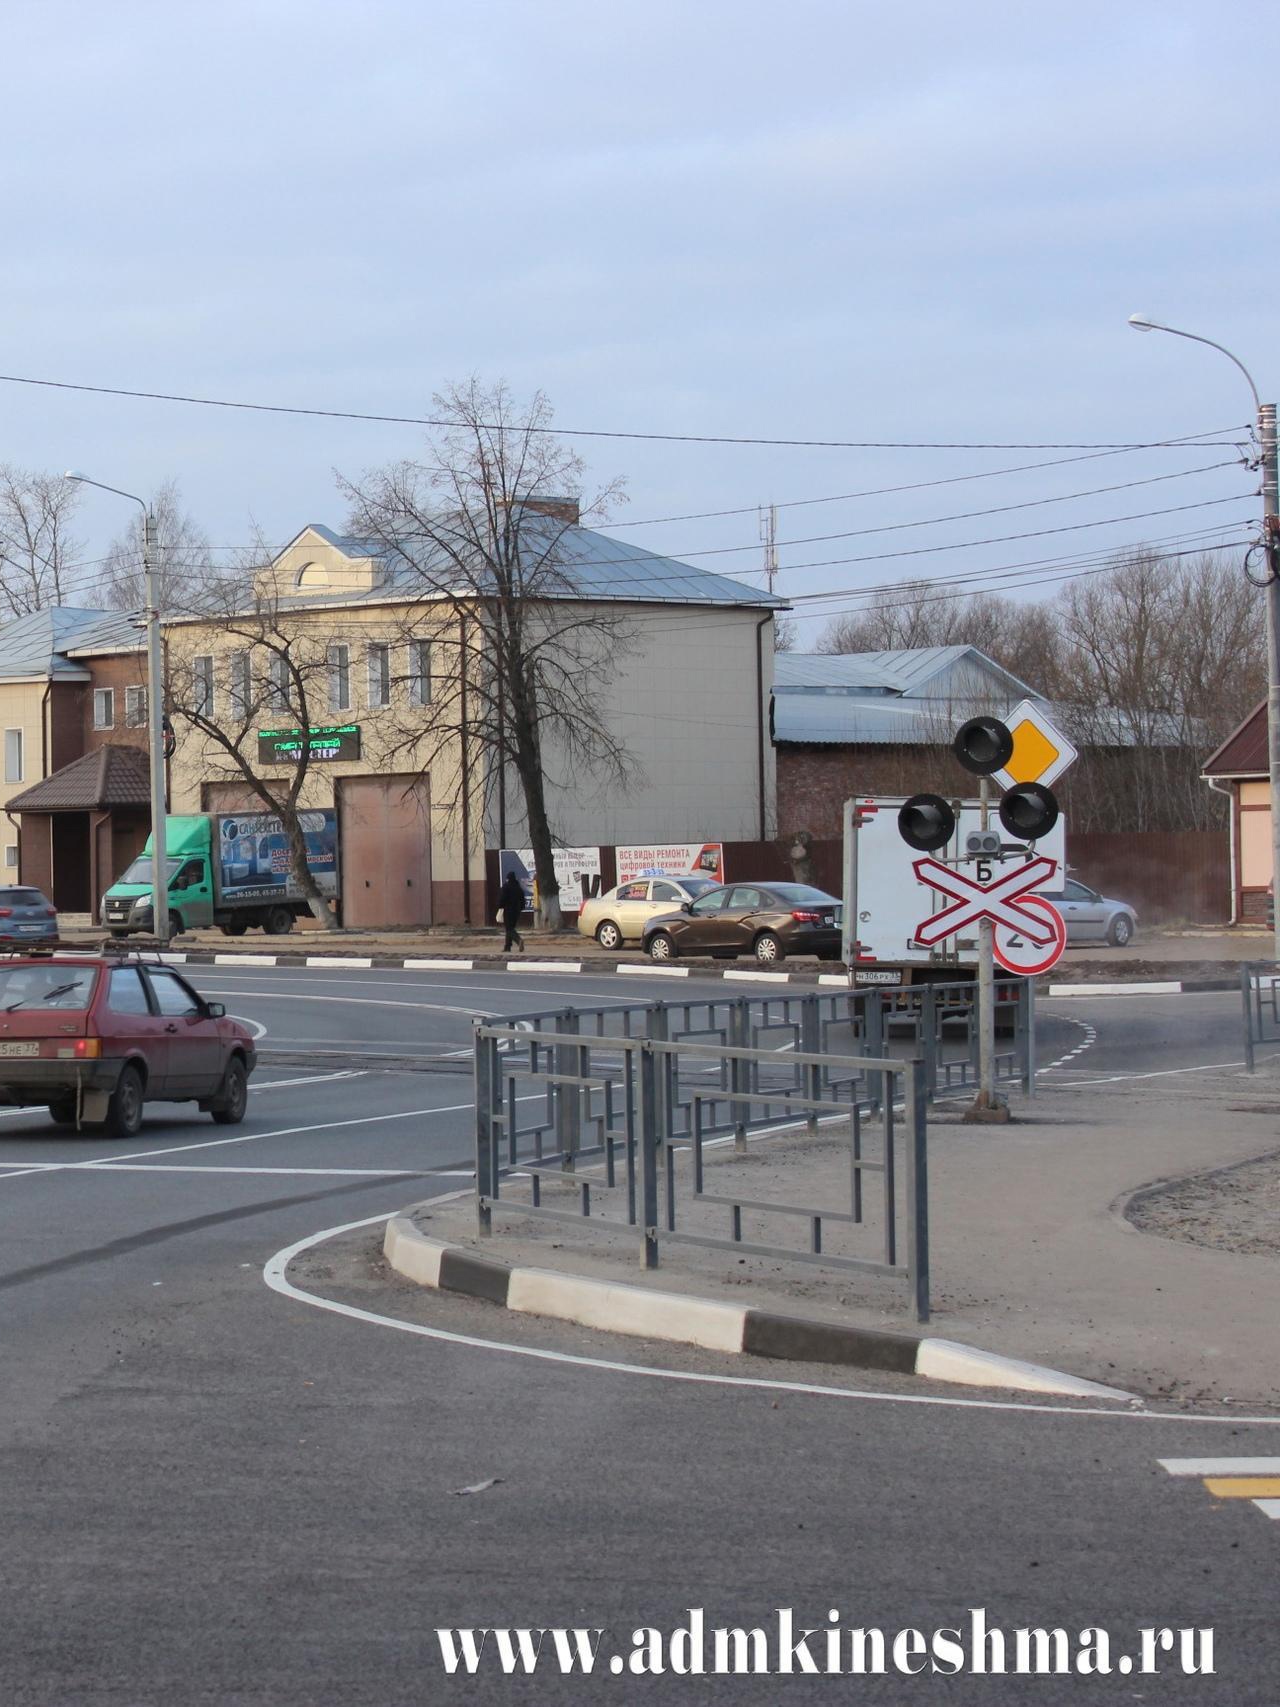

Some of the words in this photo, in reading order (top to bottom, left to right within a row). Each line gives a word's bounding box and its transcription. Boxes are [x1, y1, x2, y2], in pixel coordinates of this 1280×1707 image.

[619, 850, 633, 860] ВСЕ
[634, 849, 655, 860] ВИДЫ
[656, 848, 690, 859] РЕМОНТА
[619, 860, 655, 871] цифровой
[657, 861, 687, 869] техники
[976, 860, 993, 882] Б
